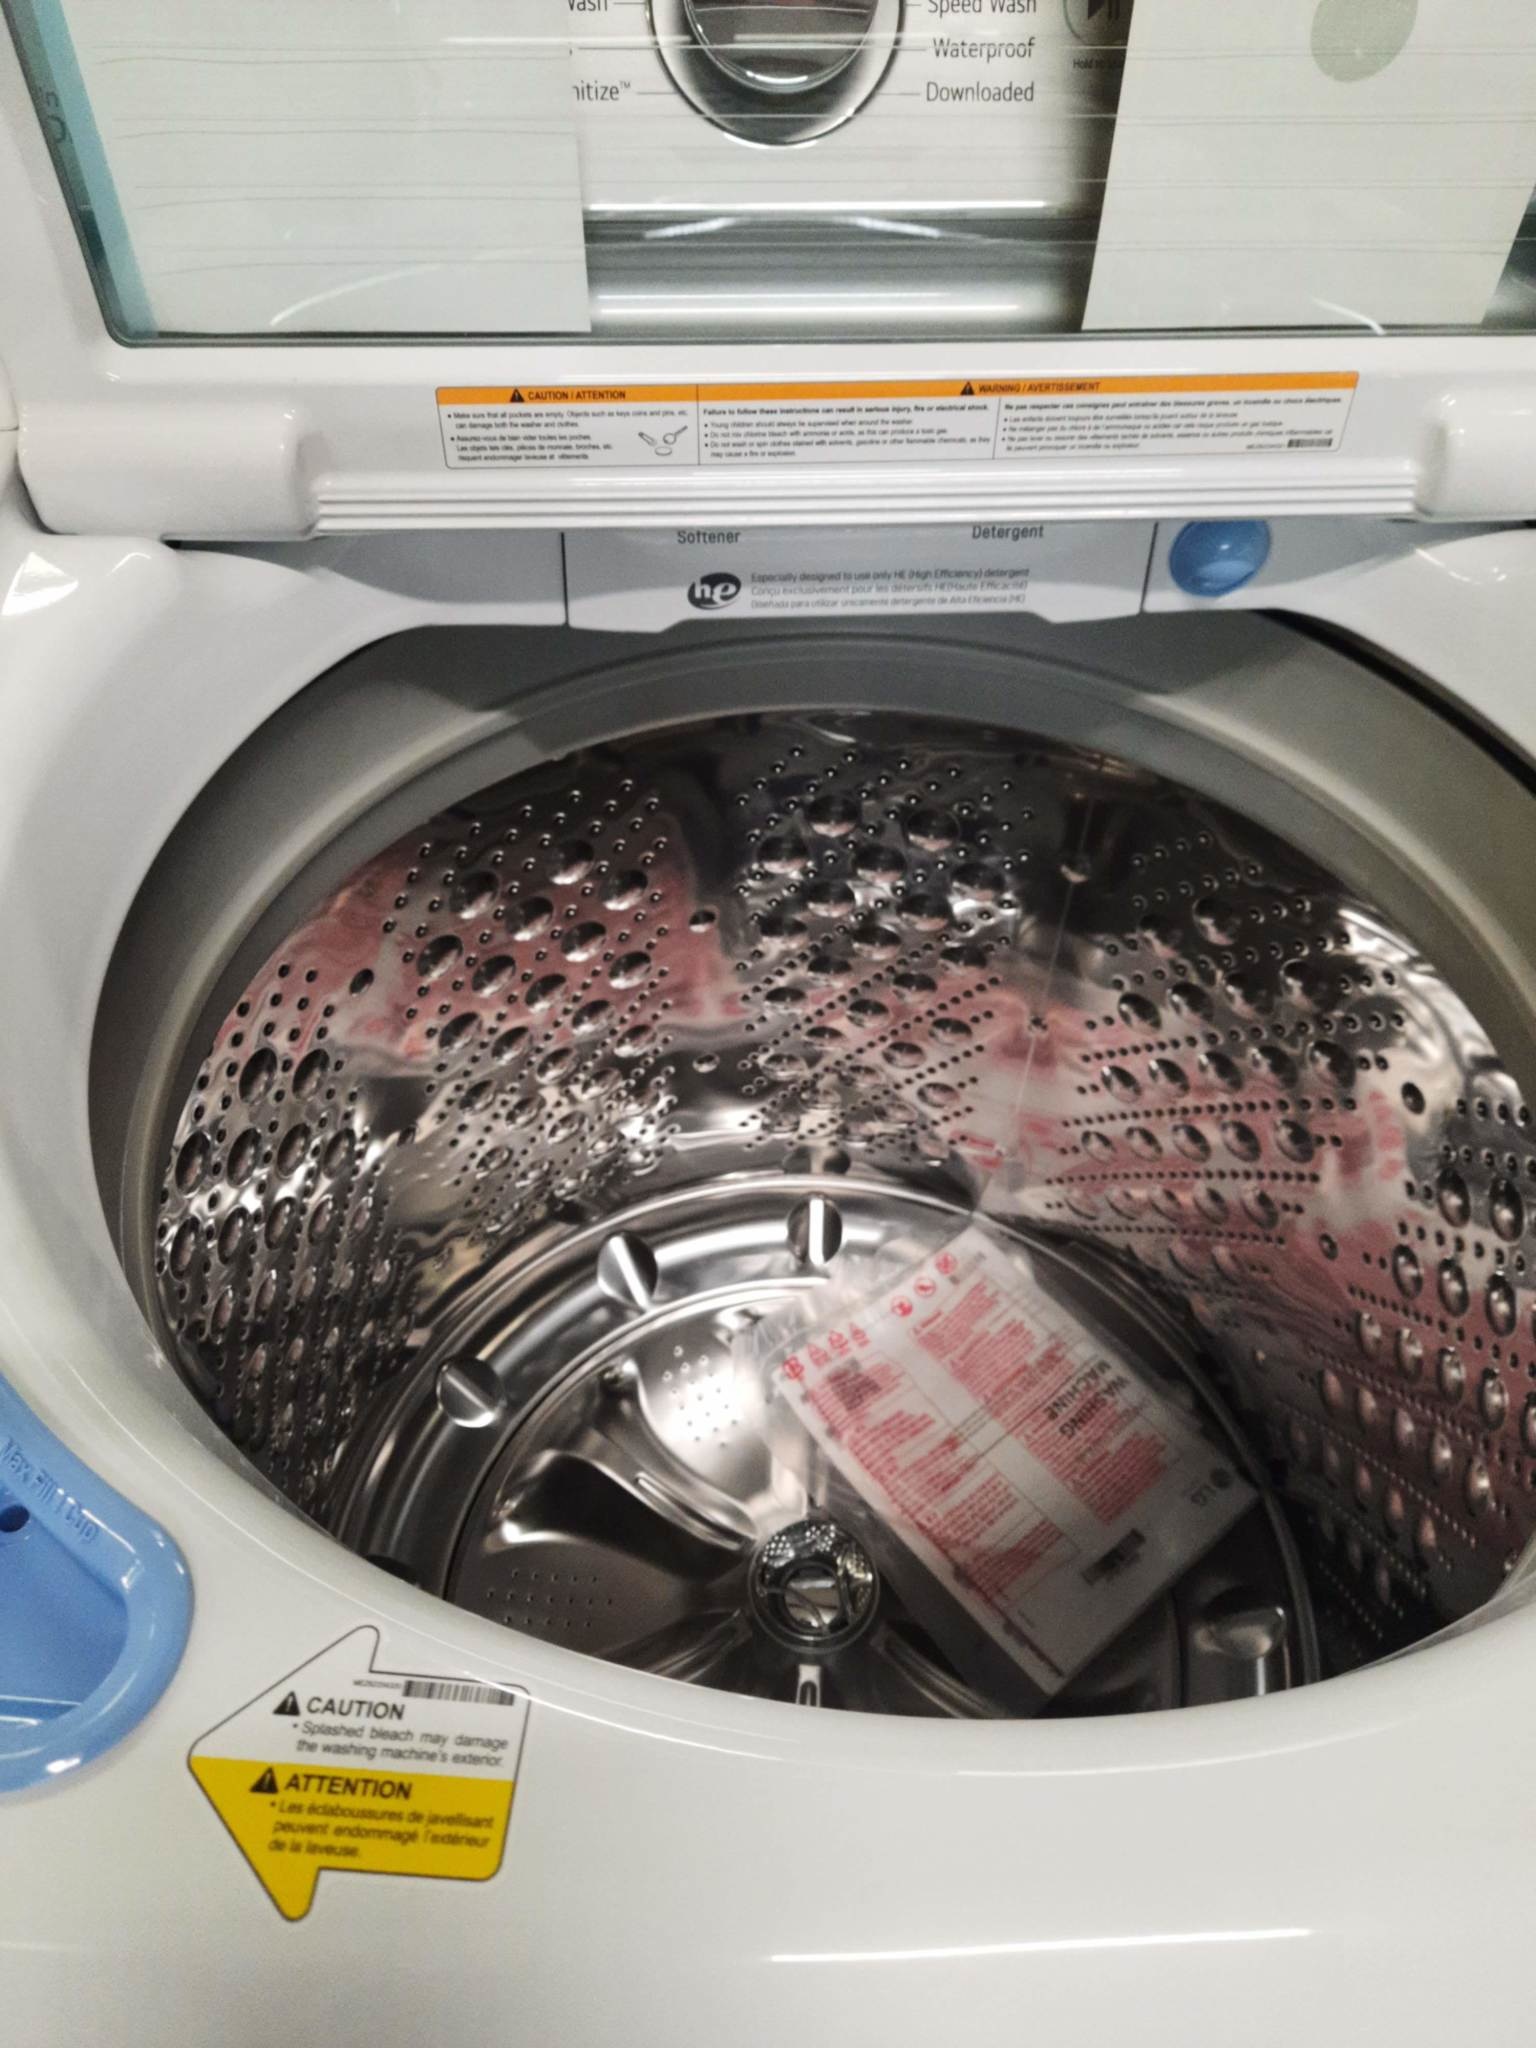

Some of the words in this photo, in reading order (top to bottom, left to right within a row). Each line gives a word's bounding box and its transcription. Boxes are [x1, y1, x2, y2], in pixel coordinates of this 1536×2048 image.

[928, 0, 982, 19] Speed
[990, 0, 1037, 13] Wash
[933, 36, 1035, 63] Waterproof
[926, 81, 1034, 101] Downloaded
[528, 391, 569, 401] CAUTION
[575, 390, 626, 400] ATTENTION
[979, 383, 1020, 393] WARNING
[1028, 381, 1101, 392] AVERTISSEMENT
[677, 529, 741, 544] Softener
[972, 525, 1044, 541] Detergent
[688, 573, 742, 610] he
[1044, 1359, 1112, 1421] MACHINE
[1058, 1375, 1128, 1440] WASHING
[306, 1696, 405, 1720] CAUTION
[302, 1721, 365, 1738] Splashed
[369, 1726, 414, 1742] bleach
[420, 1733, 449, 1748] may
[454, 1733, 508, 1752] damage
[296, 1739, 318, 1752] the
[322, 1743, 377, 1760] washing
[380, 1747, 449, 1763] machine's
[284, 1773, 412, 1800] ATTENTION
[278, 1800, 303, 1814] Les
[307, 1803, 404, 1822] éclaboussures
[407, 1811, 424, 1824] de
[273, 1821, 329, 1836] peuvent
[268, 1839, 286, 1852] de
[289, 1841, 302, 1853] la
